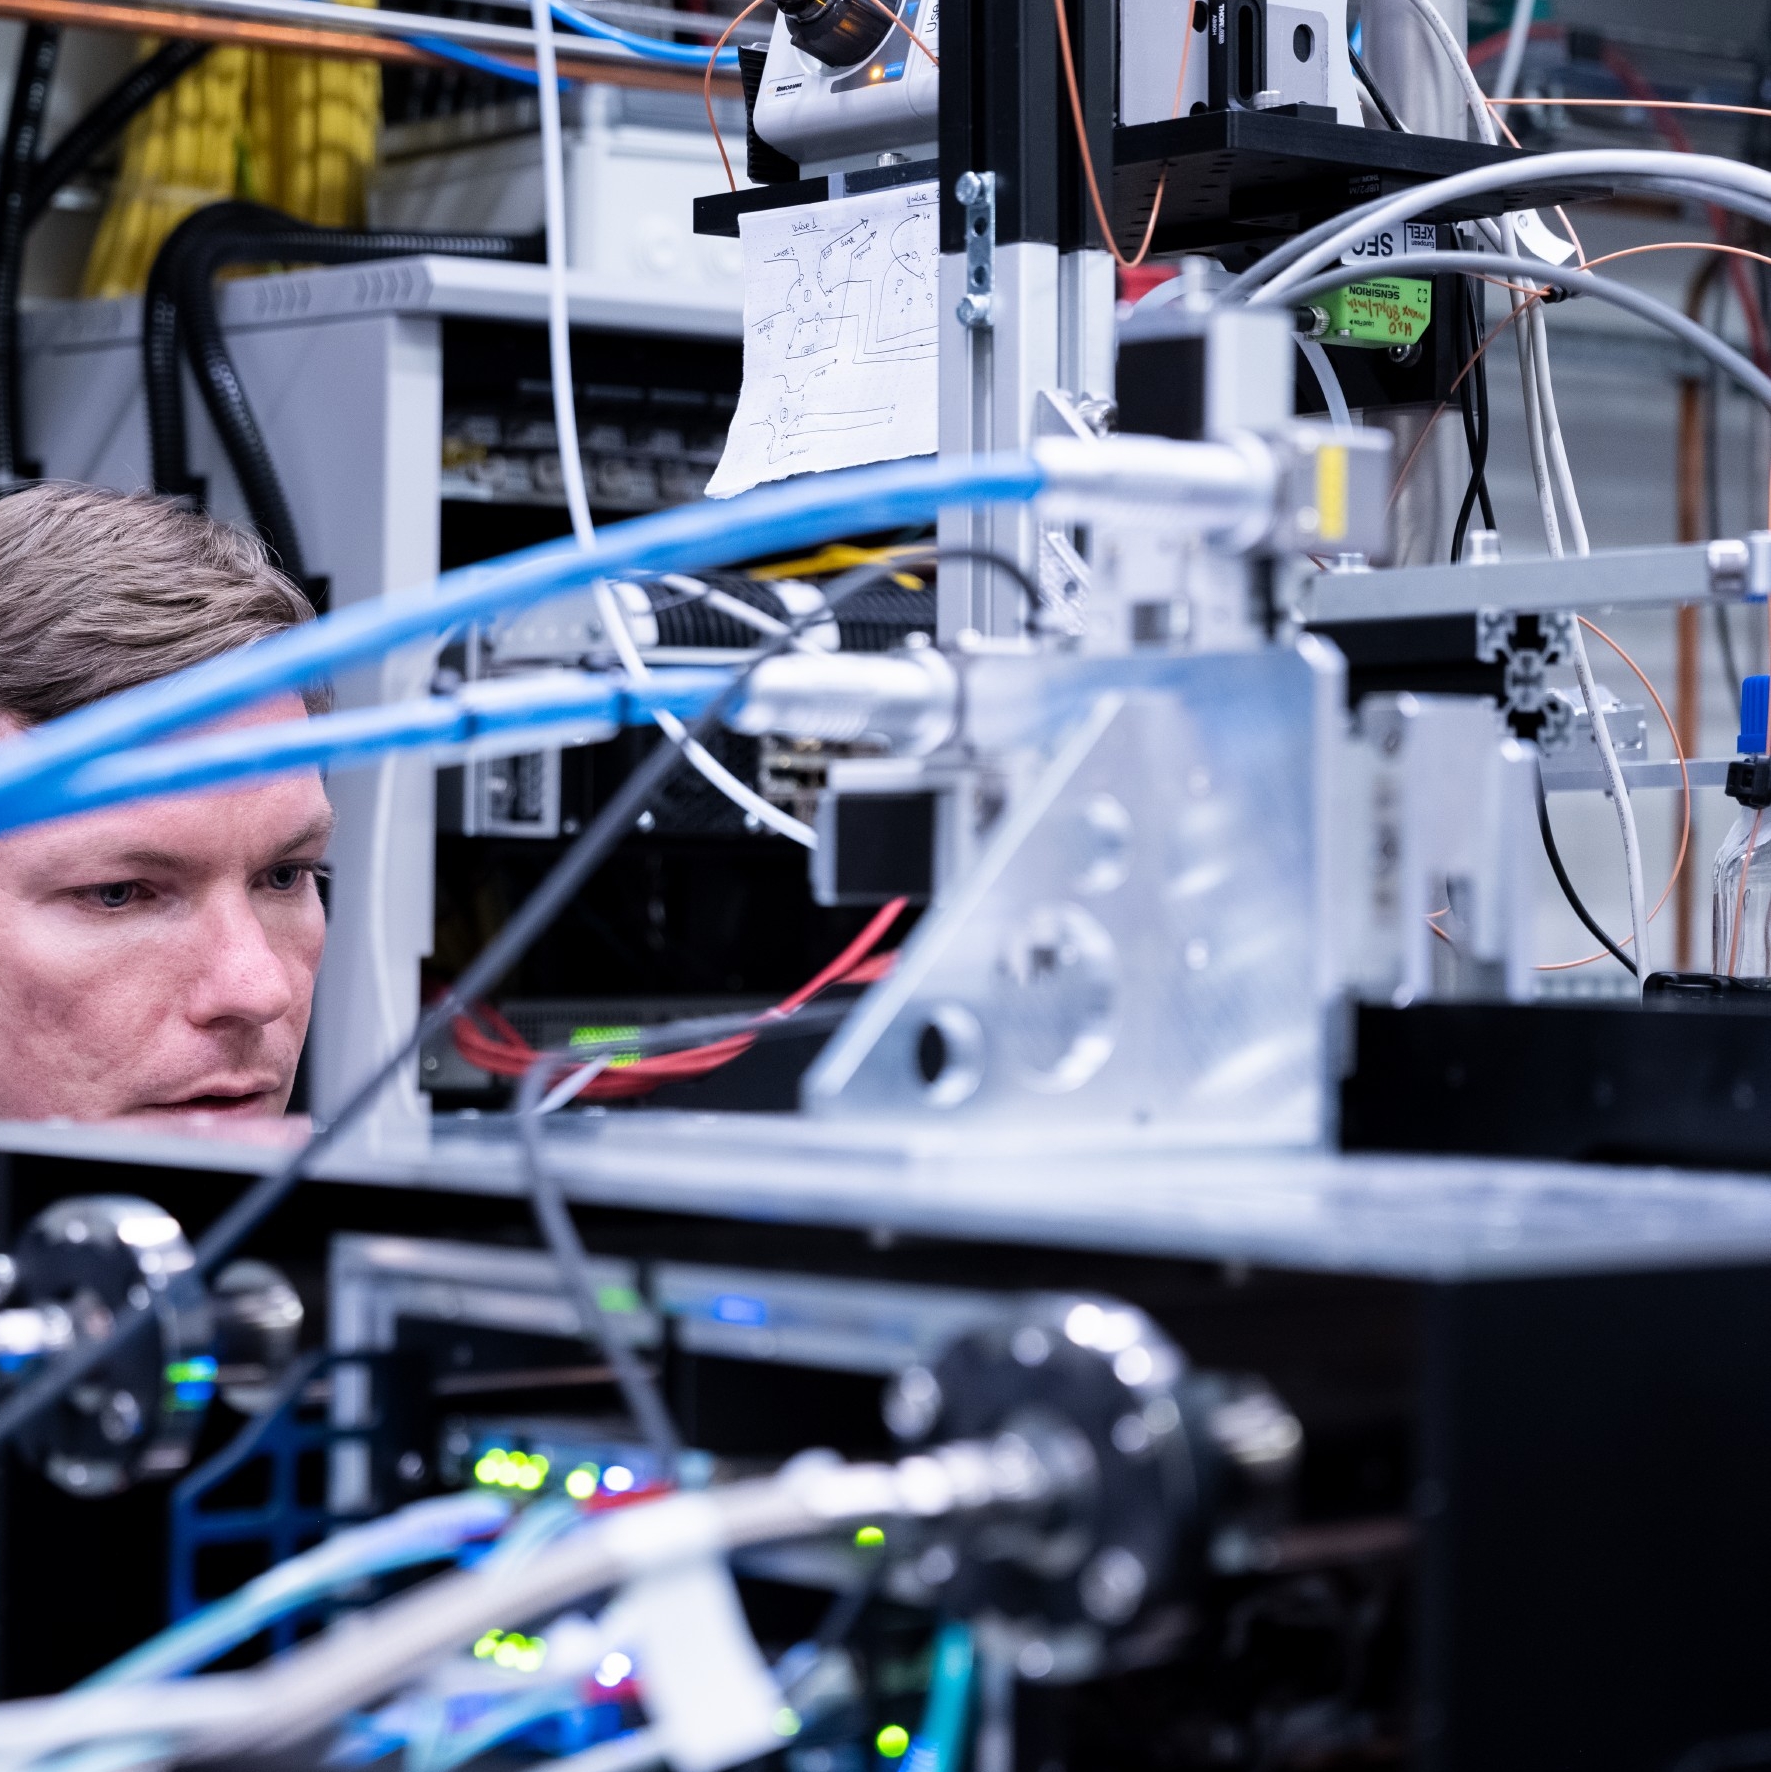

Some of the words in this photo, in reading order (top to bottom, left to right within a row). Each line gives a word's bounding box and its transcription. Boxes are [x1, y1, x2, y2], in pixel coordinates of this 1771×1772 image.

[1407, 225, 1435, 240] XFEL
[1411, 239, 1435, 249] European
[1349, 286, 1400, 300] SENSIRION
